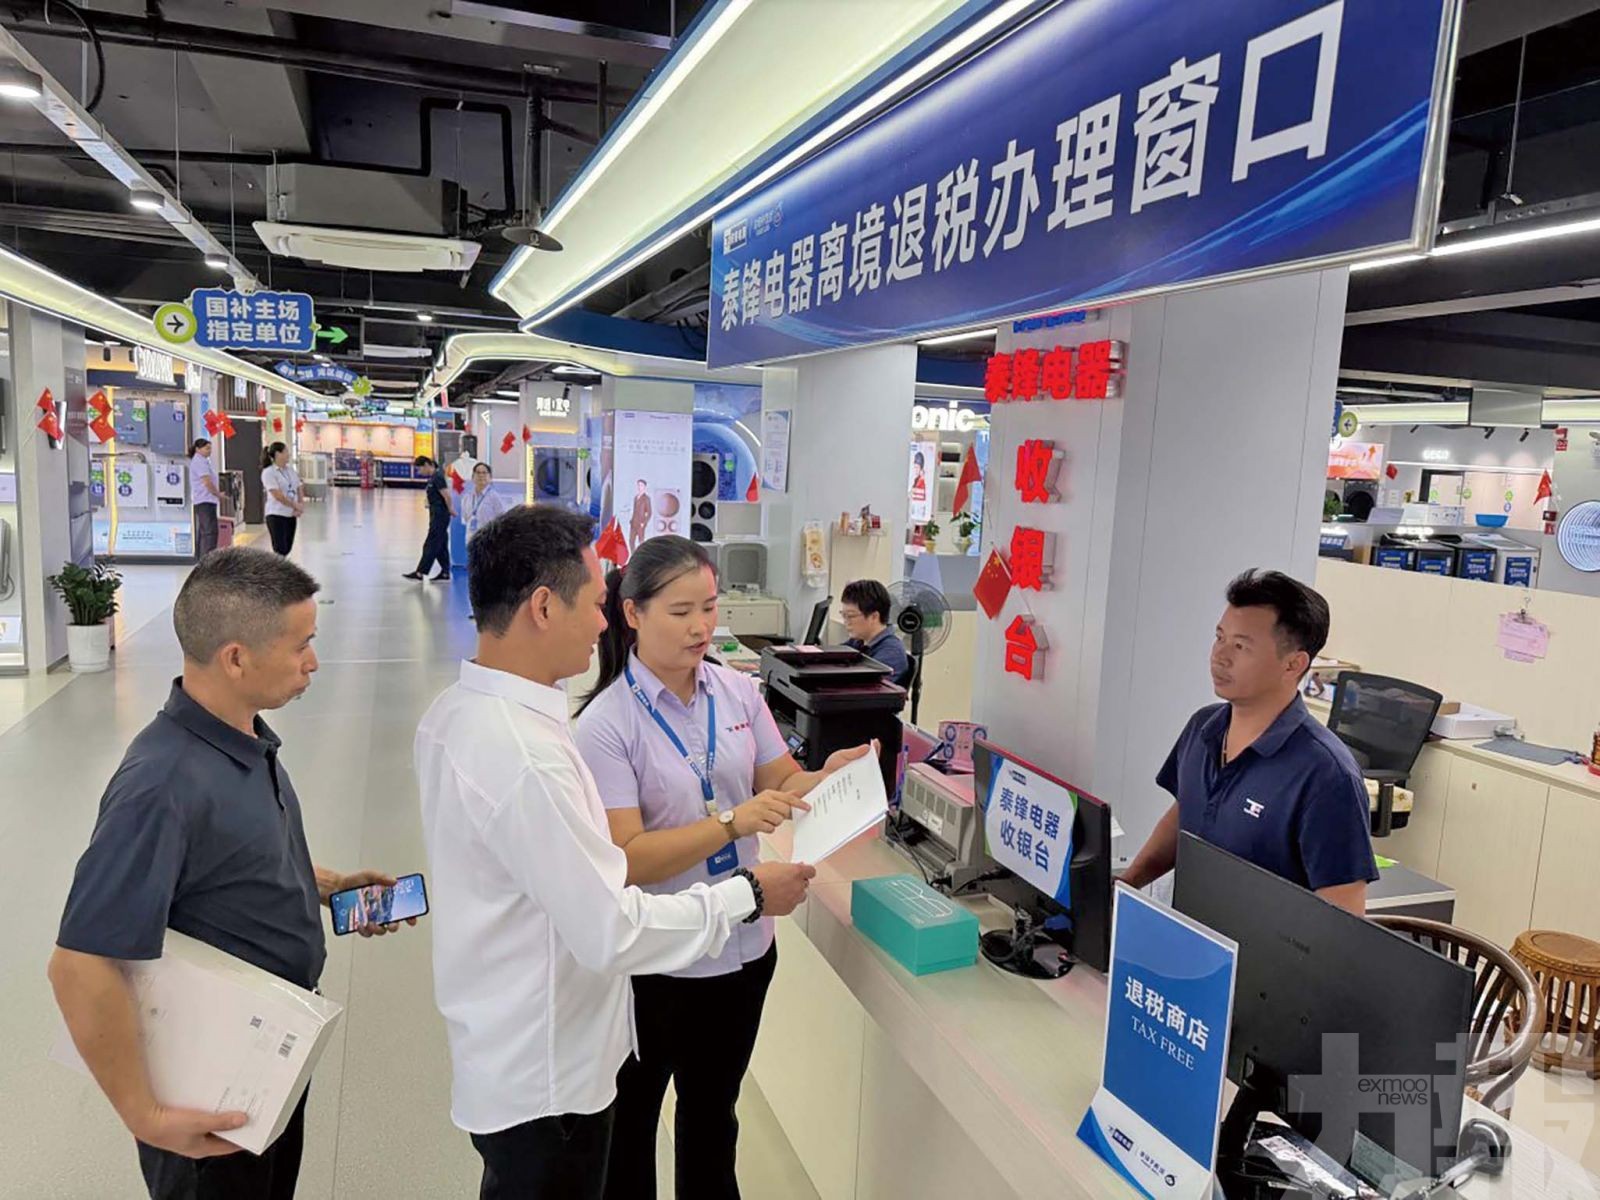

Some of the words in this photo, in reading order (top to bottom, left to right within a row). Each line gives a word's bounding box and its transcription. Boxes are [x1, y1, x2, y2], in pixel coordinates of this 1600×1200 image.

[721, 0, 1344, 331] 泰锋电器离境退税办理窗口
[206, 297, 300, 320] 国补主场
[207, 320, 302, 344] 指定单位
[985, 340, 1112, 403] 泰锋电器
[1000, 787, 1060, 840] 泰锋电器
[1000, 819, 1050, 872] 收银台
[1125, 976, 1210, 1051] 退税商店
[1131, 1016, 1157, 1044] TAX
[1160, 1037, 1195, 1070] FREE
